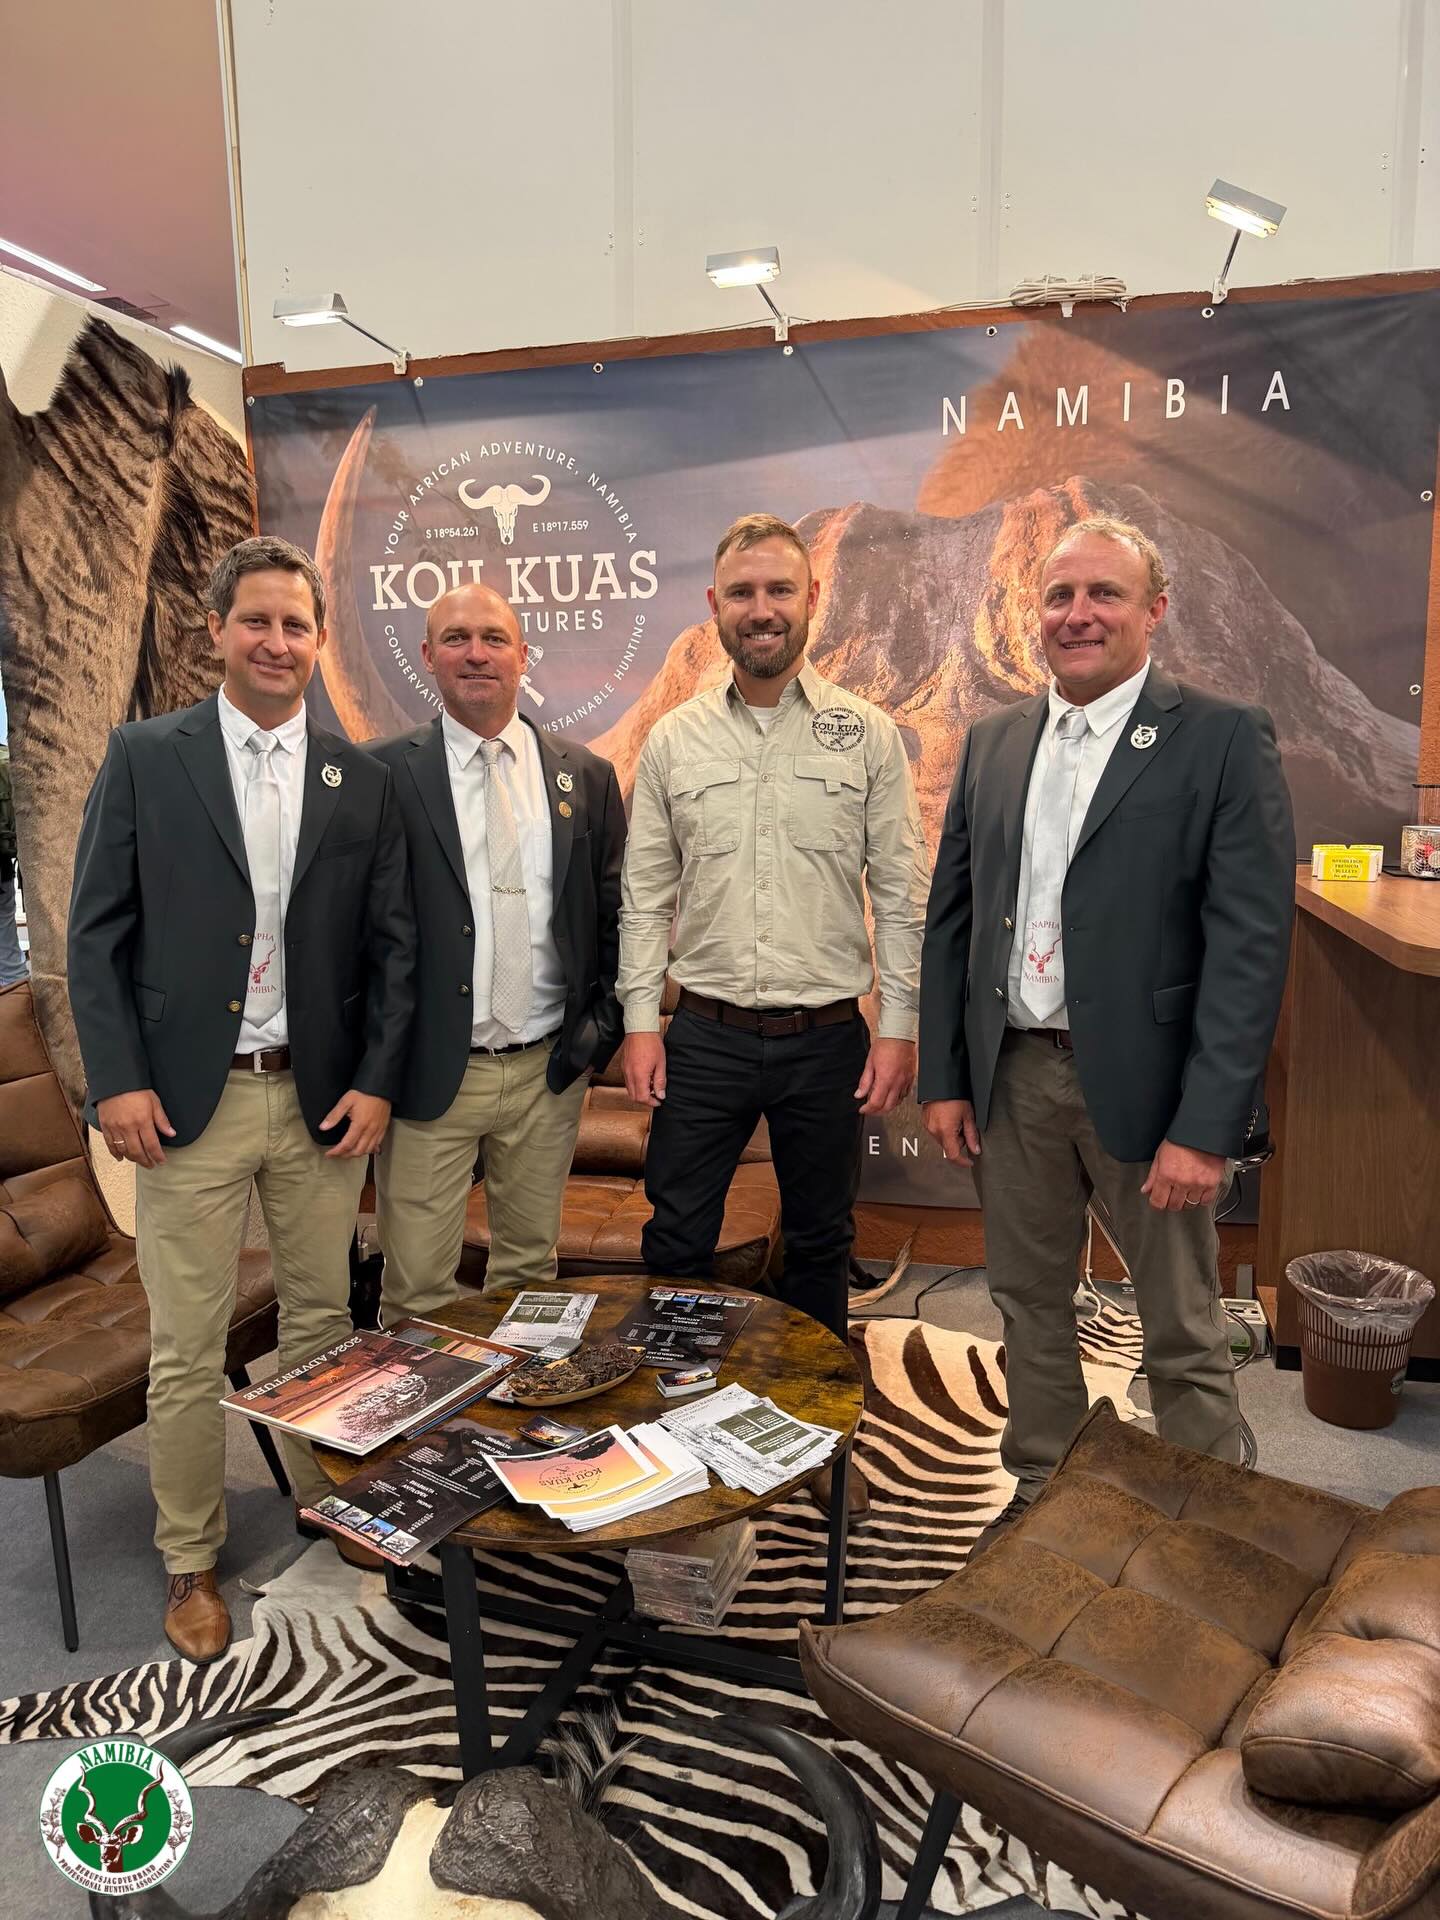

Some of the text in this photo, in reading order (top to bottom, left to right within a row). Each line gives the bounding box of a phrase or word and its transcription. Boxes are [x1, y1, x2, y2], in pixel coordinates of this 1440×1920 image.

[941, 370, 1291, 436] NAMIBIA
[384, 440, 638, 556] YOUR AFRICAN ADVENTURE, NAMIBIA
[425, 528, 433, 540] S
[532, 522, 540, 533] E
[369, 550, 659, 611] KOU KUAS
[520, 608, 604, 633] TURES
[613, 613, 646, 681] HUNTING
[811, 720, 866, 733] KOU KUAS
[1031, 920, 1060, 931] NAPHA
[1024, 972, 1060, 984] NAMIBIA
[243, 1336, 363, 1401] 2024 ADVENTURE
[575, 1467, 603, 1480] KOU
